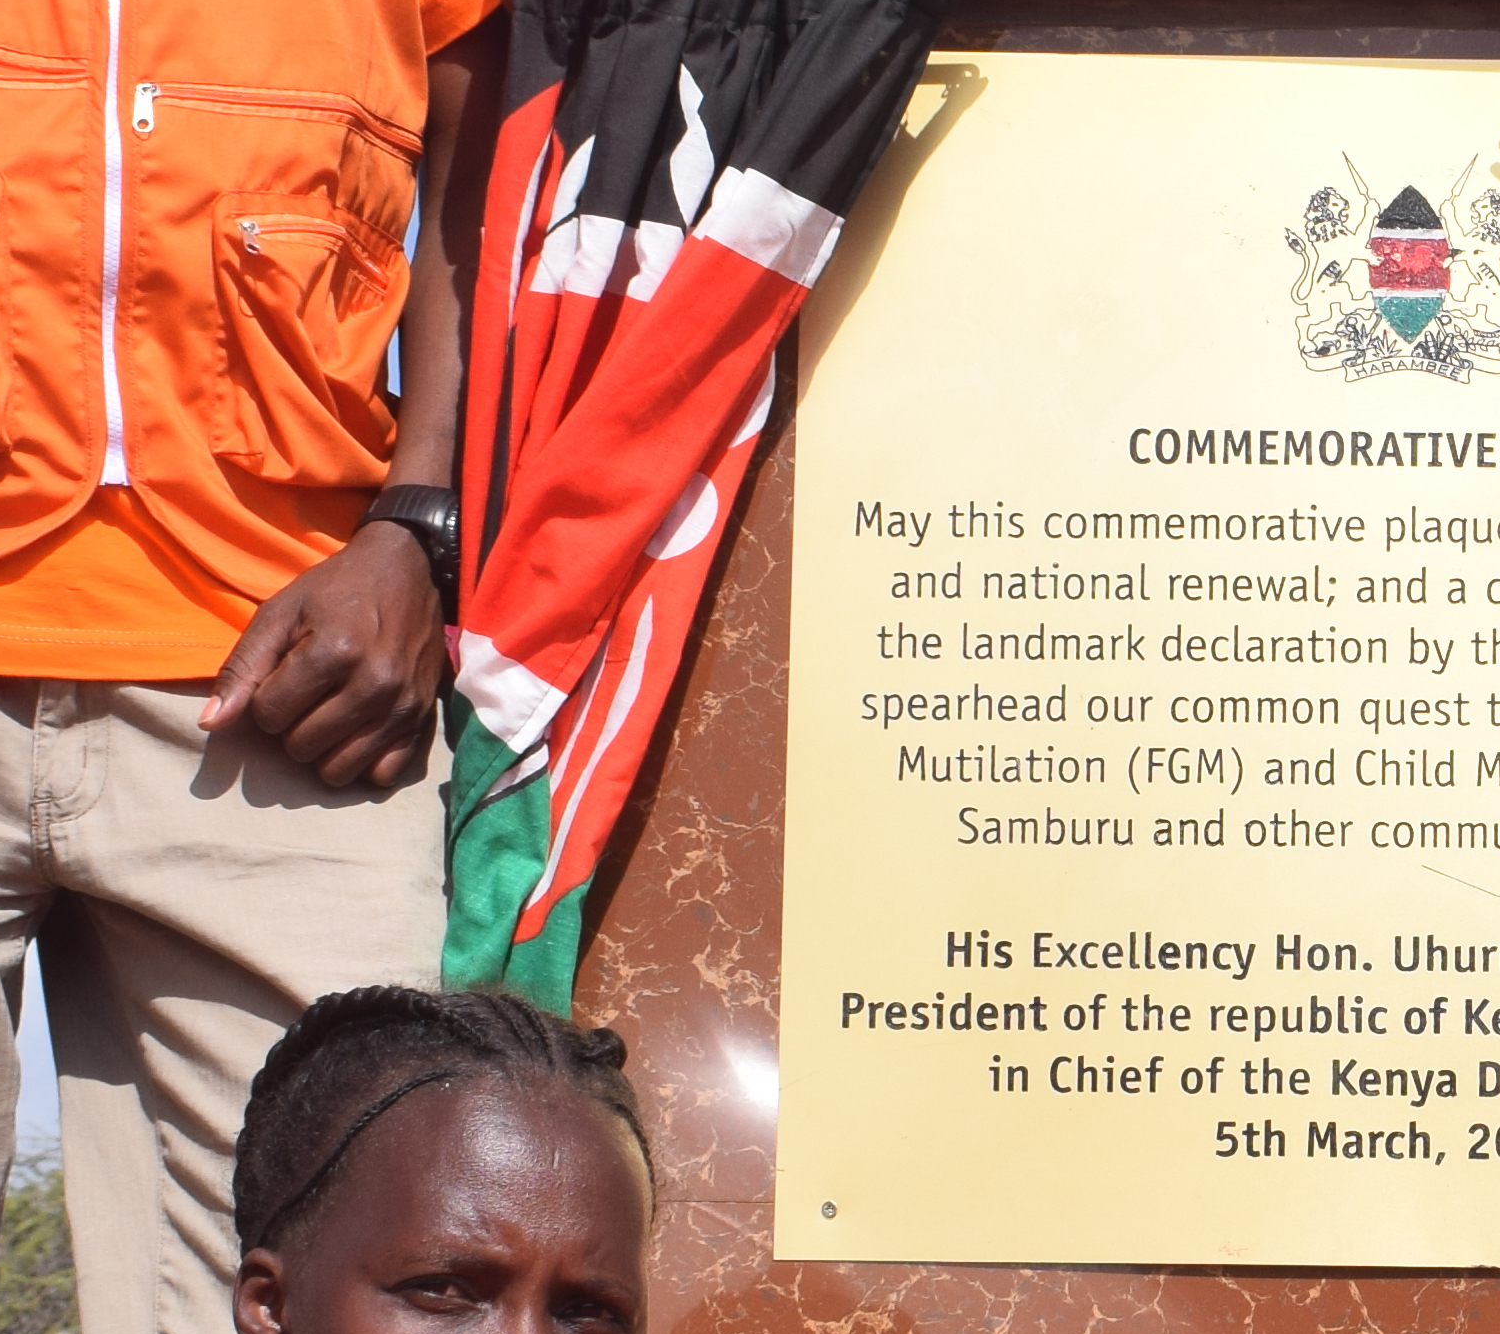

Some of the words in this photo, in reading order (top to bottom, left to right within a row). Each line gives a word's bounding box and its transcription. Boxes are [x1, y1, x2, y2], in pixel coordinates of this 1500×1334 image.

[1353, 358, 1465, 380] HARAMBEE
[1129, 427, 1497, 468] COMMEMORATIVE
[855, 501, 932, 548] May
[947, 500, 1025, 539] this
[1043, 504, 1366, 543] commemorative
[891, 561, 962, 599] and
[983, 562, 1151, 601] national
[1168, 564, 1337, 608] renewal;
[1356, 566, 1427, 604] and
[1447, 577, 1467, 605] a
[876, 621, 943, 660] the
[962, 622, 1146, 661] landmark
[1161, 623, 1387, 664] declaration
[1408, 626, 1455, 675] by
[861, 682, 1067, 730] spearhead
[1087, 695, 1154, 723] our
[1170, 696, 1339, 725] common
[1360, 692, 1471, 735] quest
[898, 744, 1105, 784] Mutilation
[1128, 745, 1244, 796] (FGM)
[1264, 747, 1335, 786] and
[1355, 748, 1456, 788] Child
[957, 806, 1134, 846] Samburu
[1153, 807, 1225, 848] and
[1244, 808, 1354, 848] other
[946, 929, 1013, 970] His
[1033, 931, 1257, 981] Excellency
[1275, 933, 1373, 972] Hon.
[841, 991, 1048, 1032] President
[1063, 993, 1108, 1031] of
[1120, 993, 1192, 1032] the
[1209, 994, 1388, 1043] republic
[1403, 996, 1449, 1035] of
[988, 1054, 1029, 1093] in
[1049, 1054, 1165, 1094] Chief
[1180, 1056, 1226, 1095] of
[1240, 1056, 1311, 1096] the
[1331, 1058, 1458, 1108] Kenya
[1215, 1118, 1286, 1158] 5th
[1306, 1120, 1447, 1166] March,
